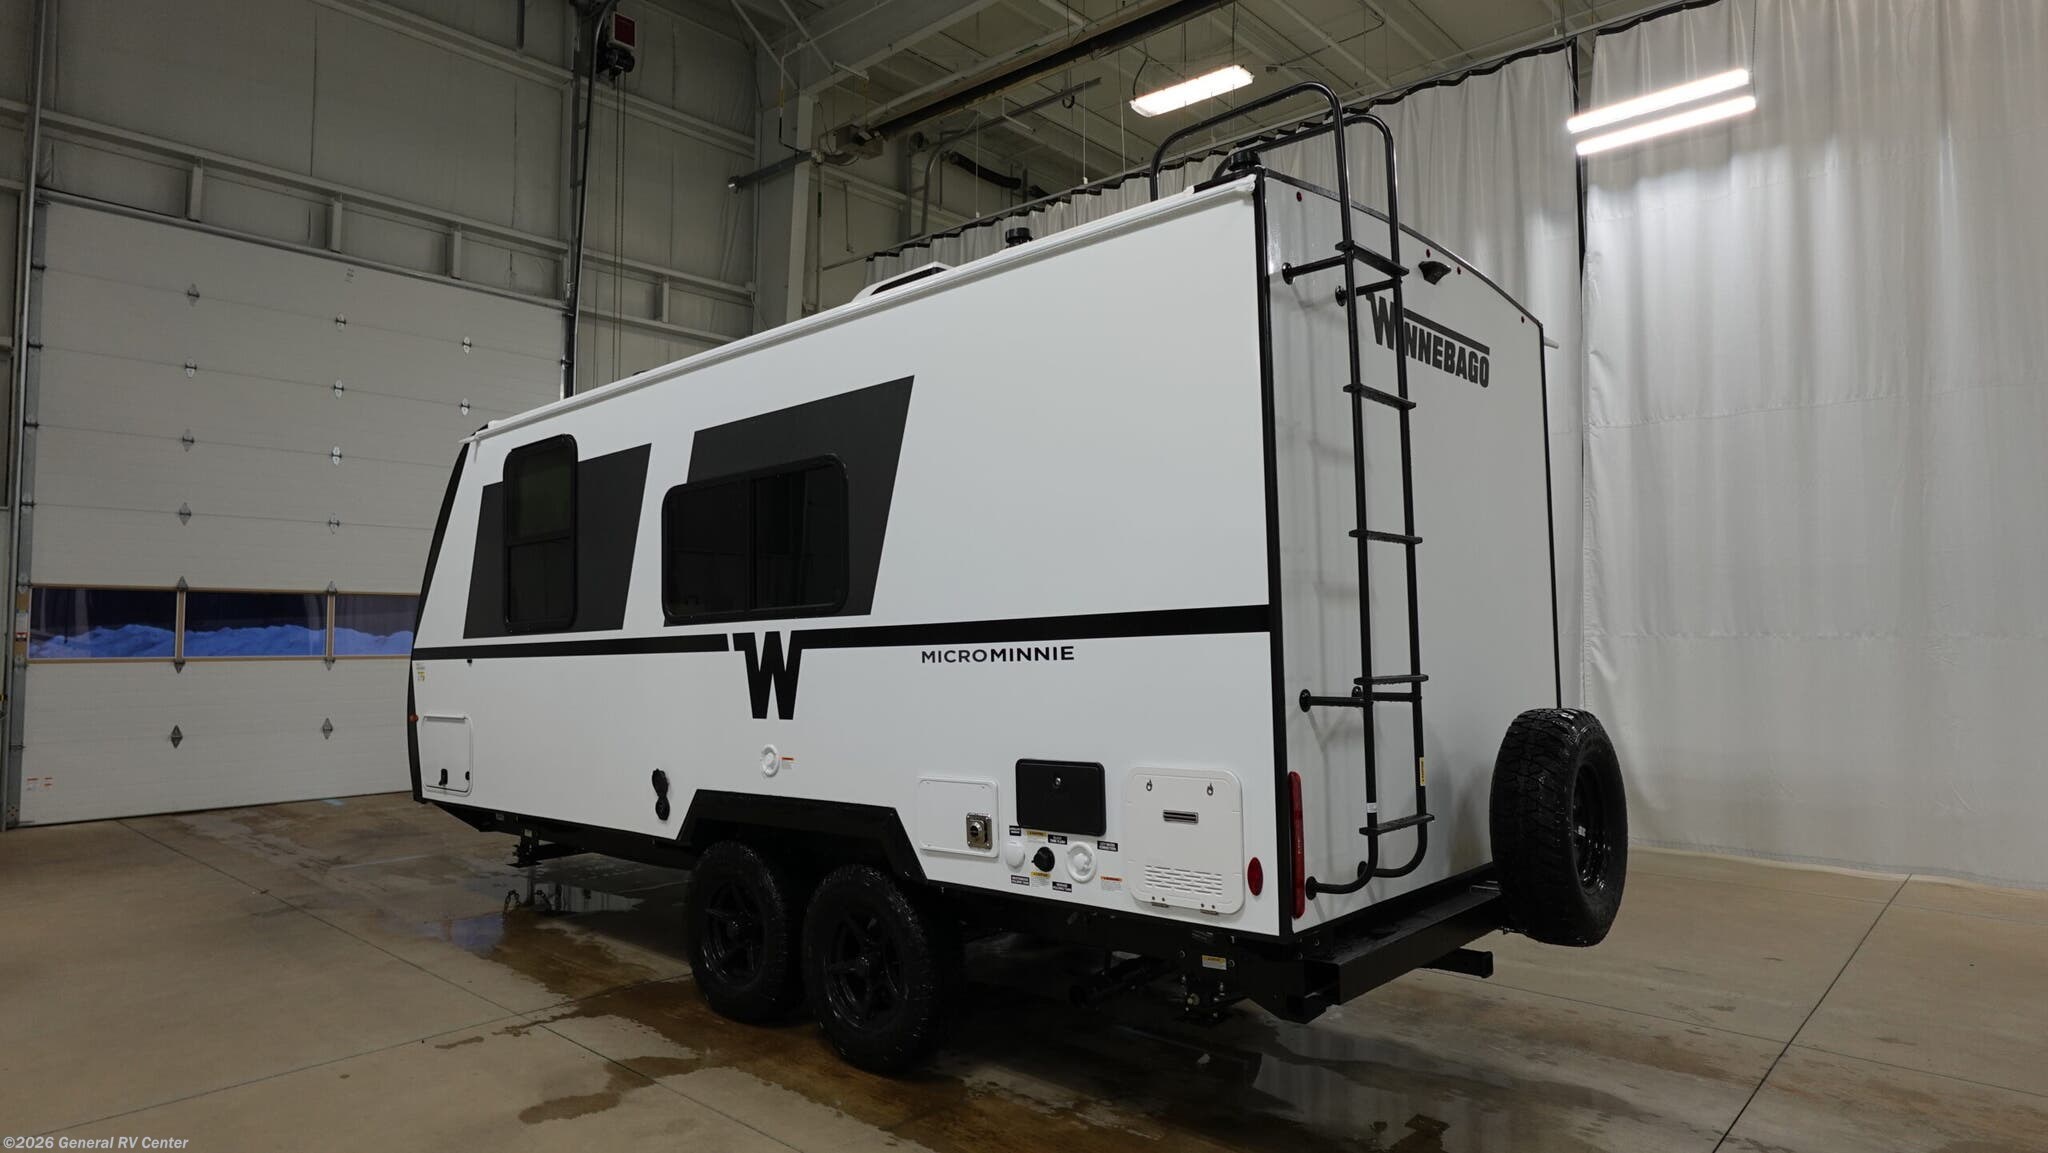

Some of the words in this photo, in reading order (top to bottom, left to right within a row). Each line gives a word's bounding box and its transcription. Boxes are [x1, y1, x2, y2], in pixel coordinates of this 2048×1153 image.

[1365, 292, 1490, 388] WNNEBAGO
[733, 630, 802, 720] W
[921, 645, 1075, 664] MICROMINNIE
